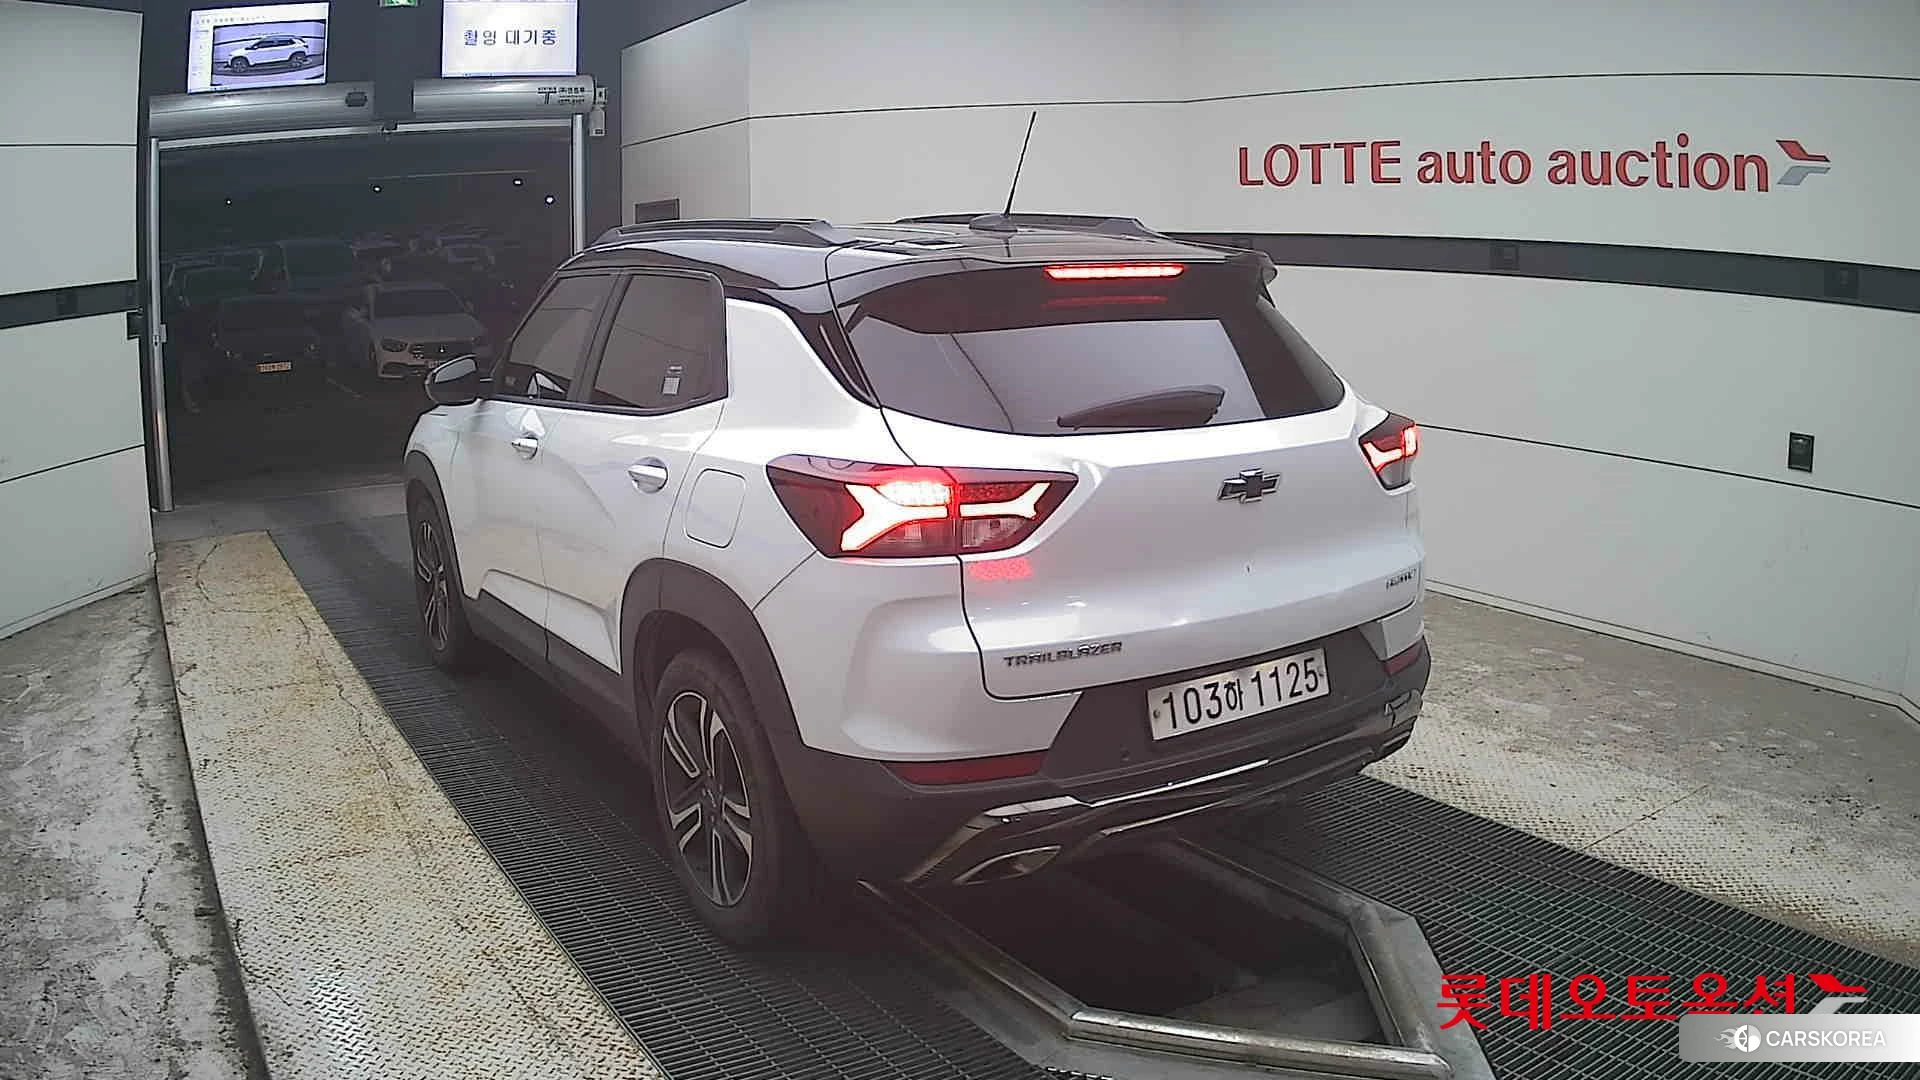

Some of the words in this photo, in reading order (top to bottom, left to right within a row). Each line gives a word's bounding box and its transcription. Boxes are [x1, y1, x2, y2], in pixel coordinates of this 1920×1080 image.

[505, 29, 557, 46] 대기중
[1239, 140, 1401, 187] LOTTE
[1417, 141, 1531, 184] auto
[1548, 133, 1768, 192] auction
[1003, 641, 1122, 667] TRAILBLAZER
[1162, 678, 1243, 729] 103하
[1251, 657, 1319, 706] 1125
